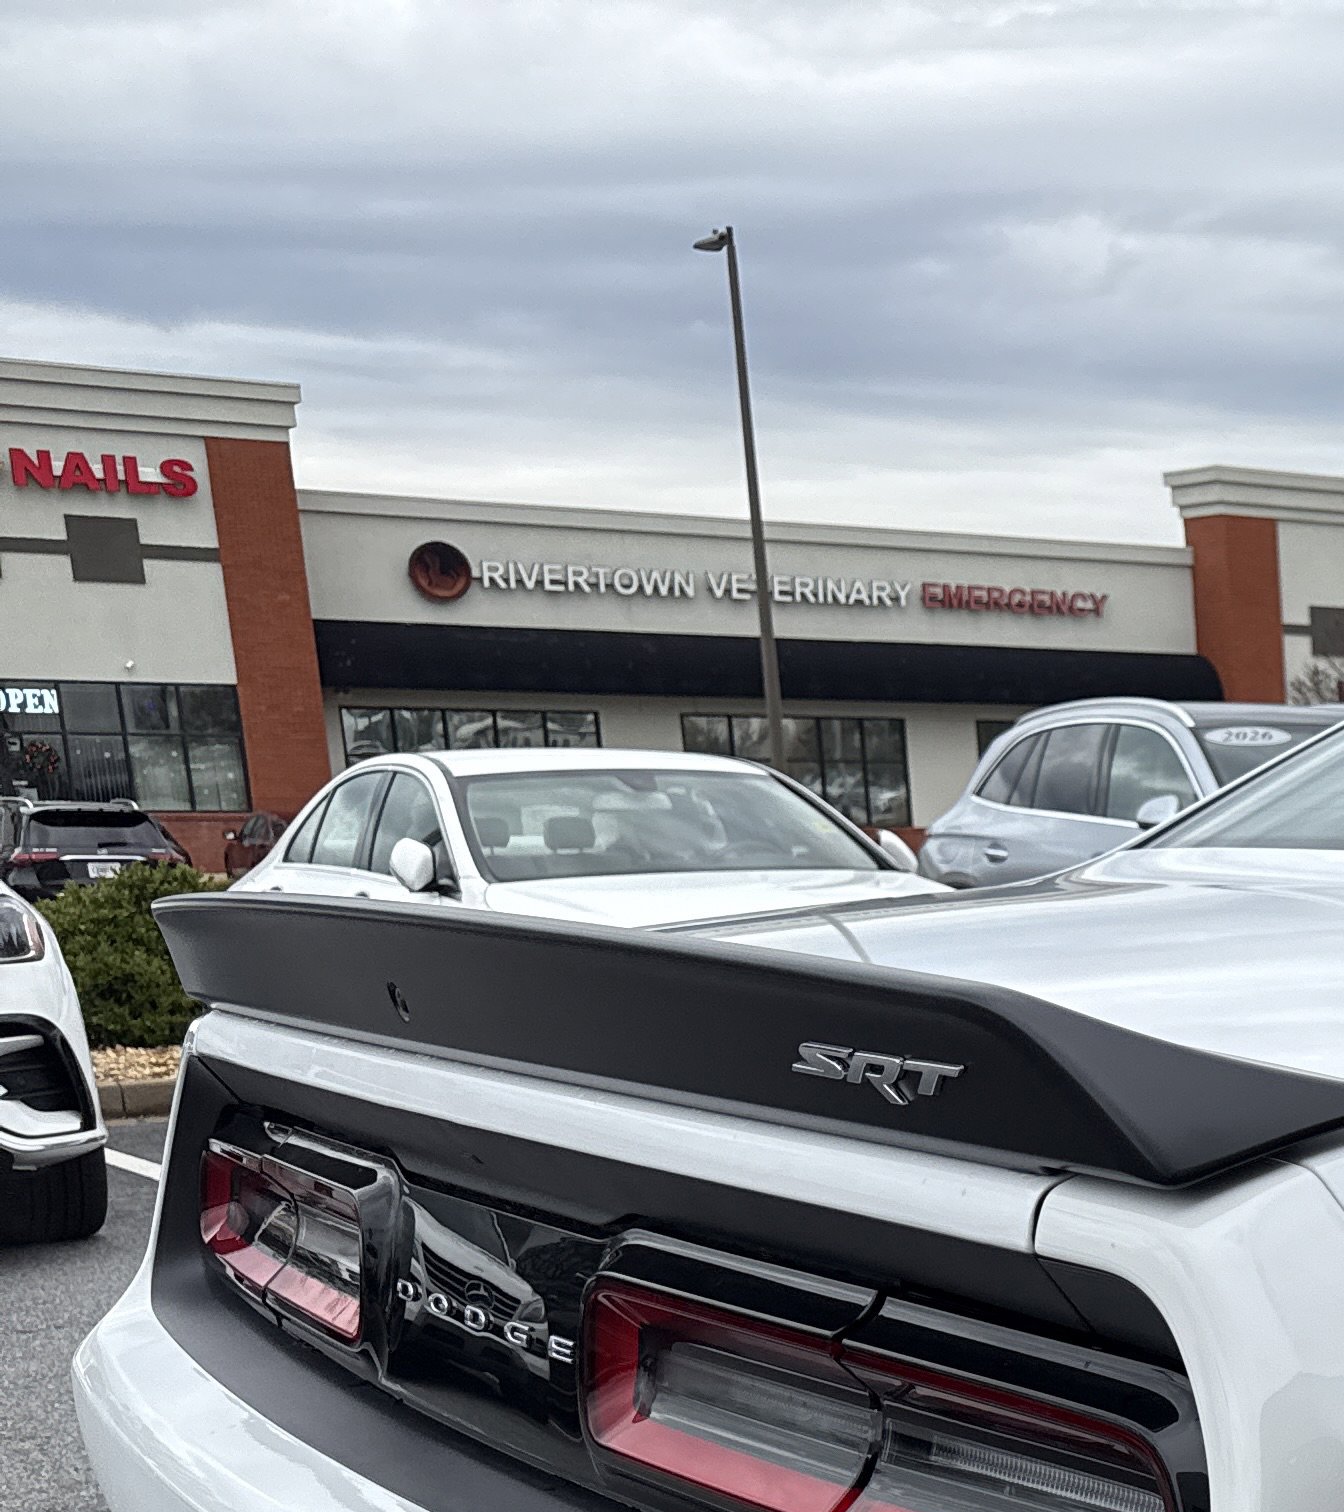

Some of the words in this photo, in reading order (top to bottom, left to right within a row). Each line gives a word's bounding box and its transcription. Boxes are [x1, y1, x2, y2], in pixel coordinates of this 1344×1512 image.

[9, 447, 199, 498] NAILS
[481, 559, 696, 599] RIVERTOWN
[705, 570, 912, 608] VEERINARY
[921, 581, 1111, 619] EMERGENCY
[1222, 729, 1273, 742] 2026
[791, 1041, 965, 1105] SRT
[397, 1277, 576, 1365] DODGE
